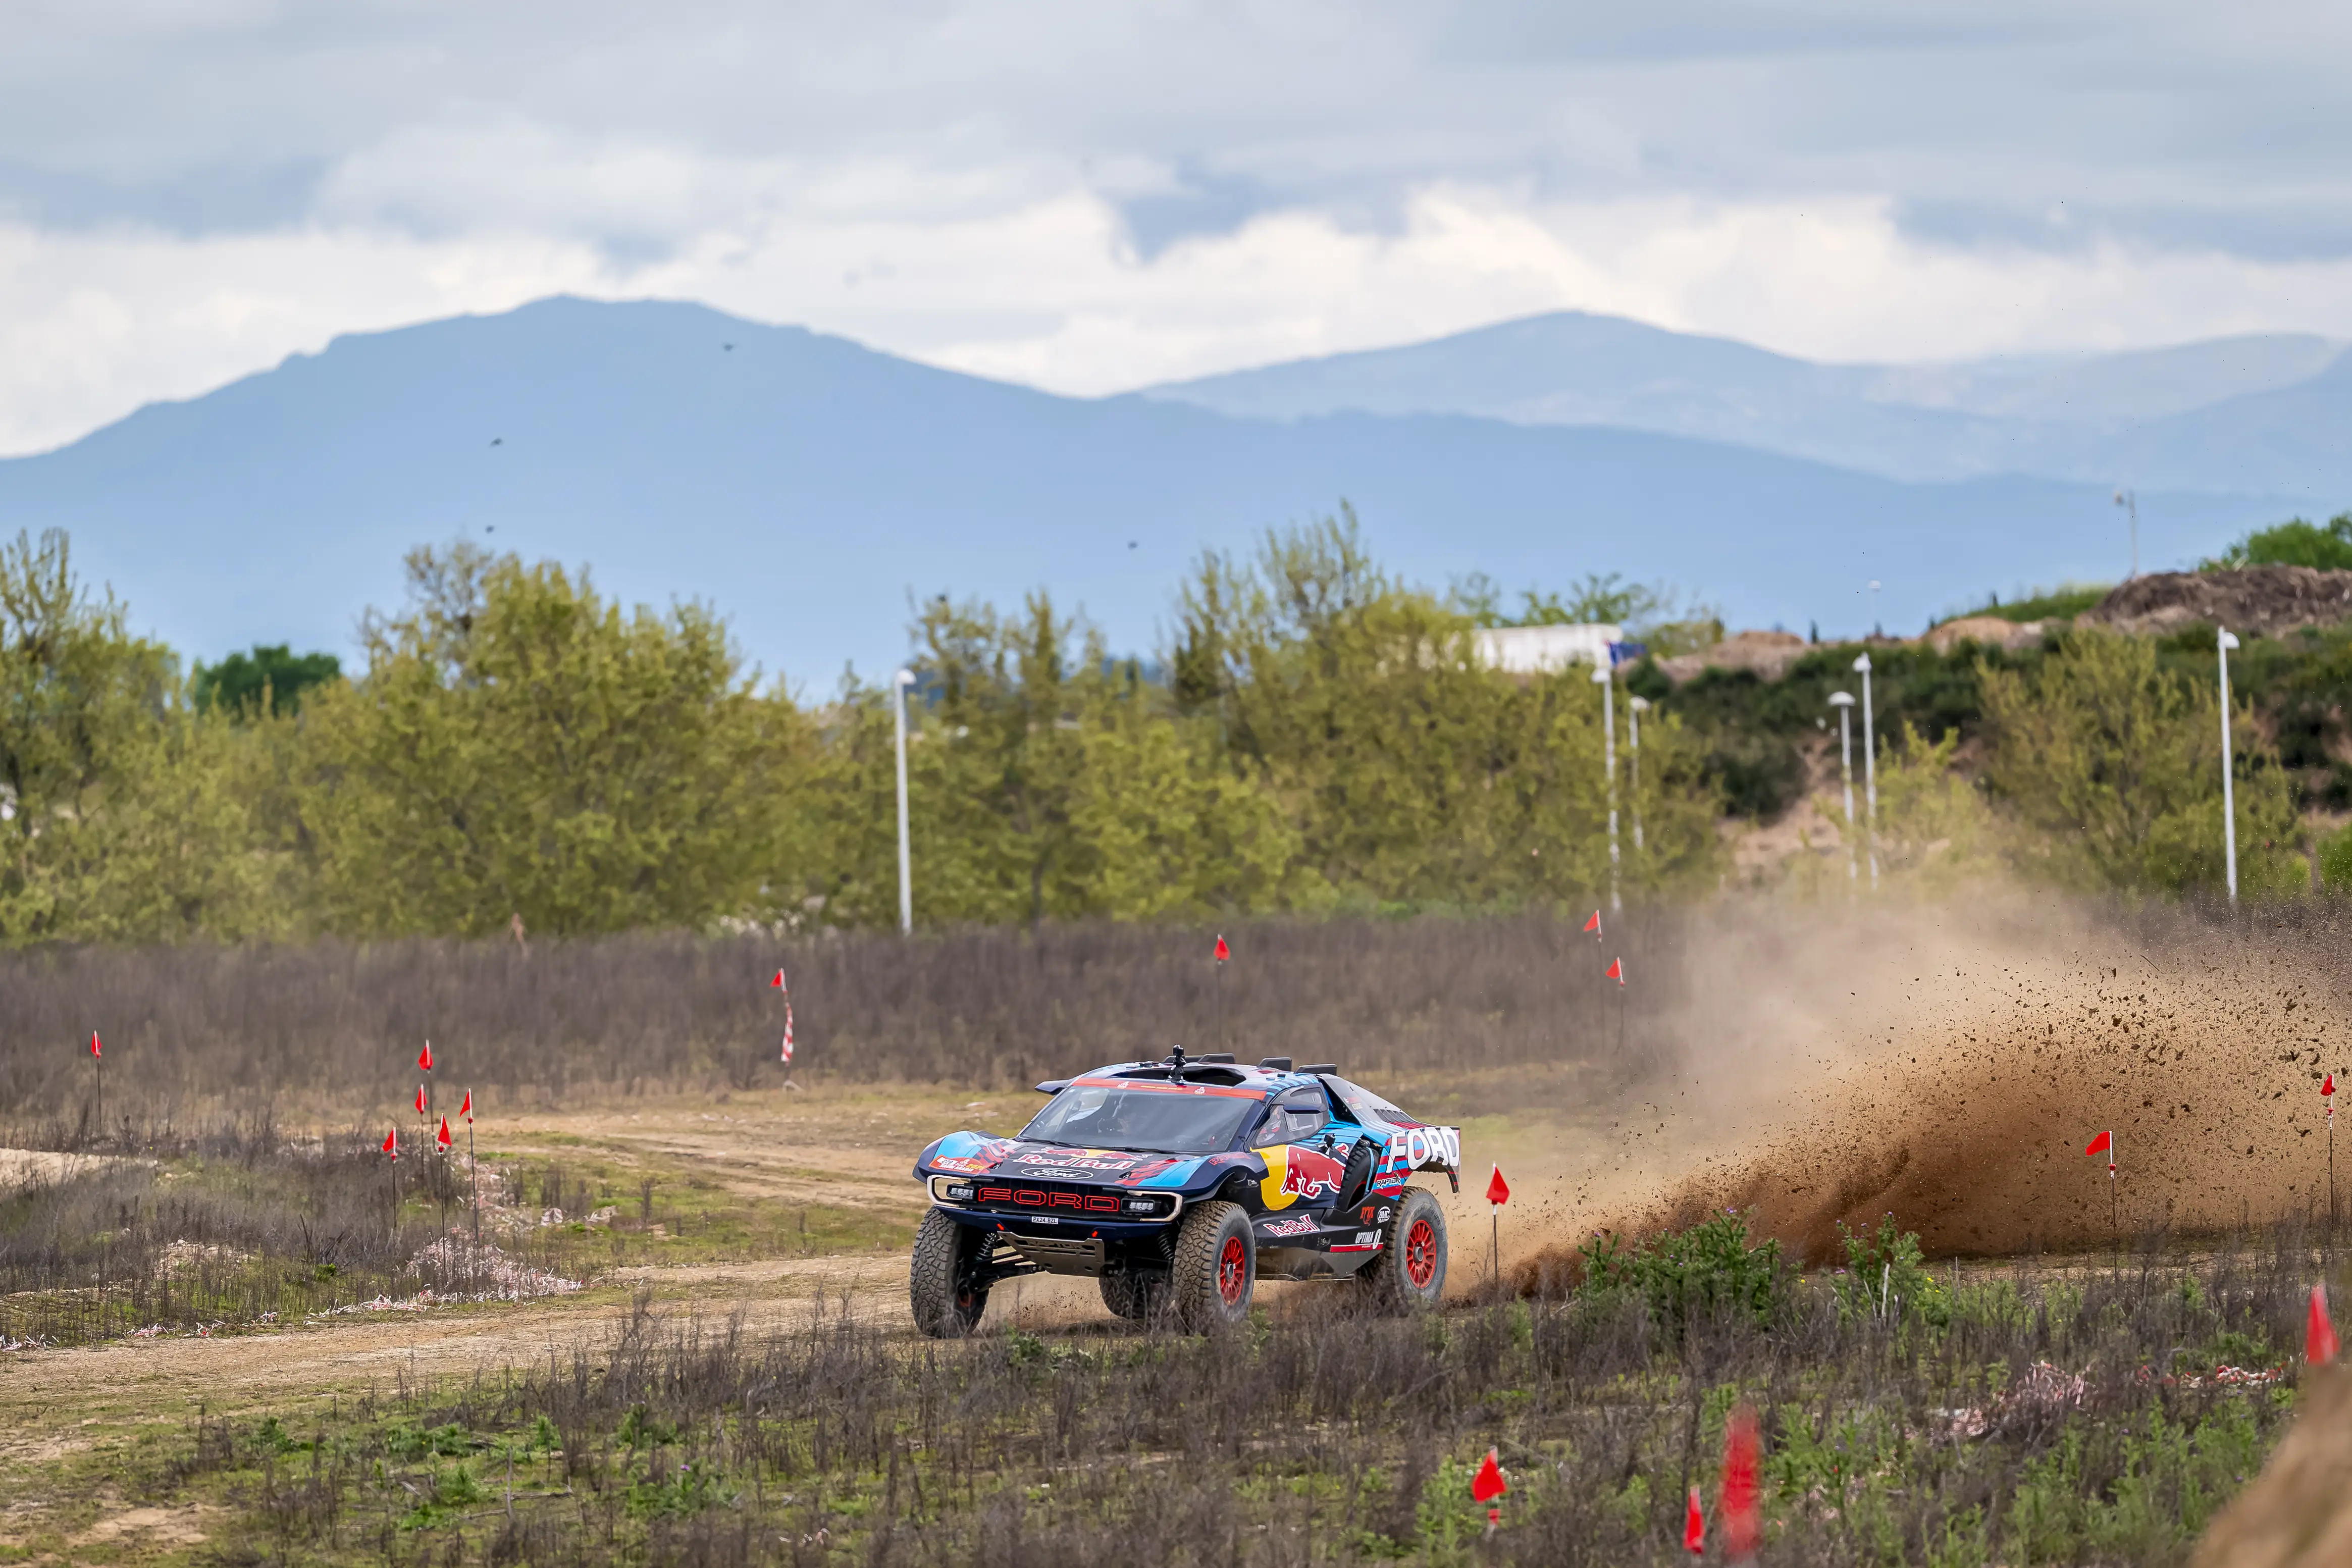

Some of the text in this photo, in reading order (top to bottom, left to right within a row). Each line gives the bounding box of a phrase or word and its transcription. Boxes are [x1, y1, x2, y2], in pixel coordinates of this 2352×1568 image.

[1386, 1127, 1460, 1173] FORD
[1014, 1154, 1136, 1170] Red Bull
[1033, 1168, 1081, 1178] Ford
[1377, 1175, 1401, 1189] RAPTOR
[978, 1188, 1119, 1212] FORD
[1360, 1206, 1375, 1220] FOX
[1379, 1210, 1390, 1219] BMC
[1263, 1214, 1321, 1237] Red Bull
[1355, 1232, 1373, 1243] OPTIMA
